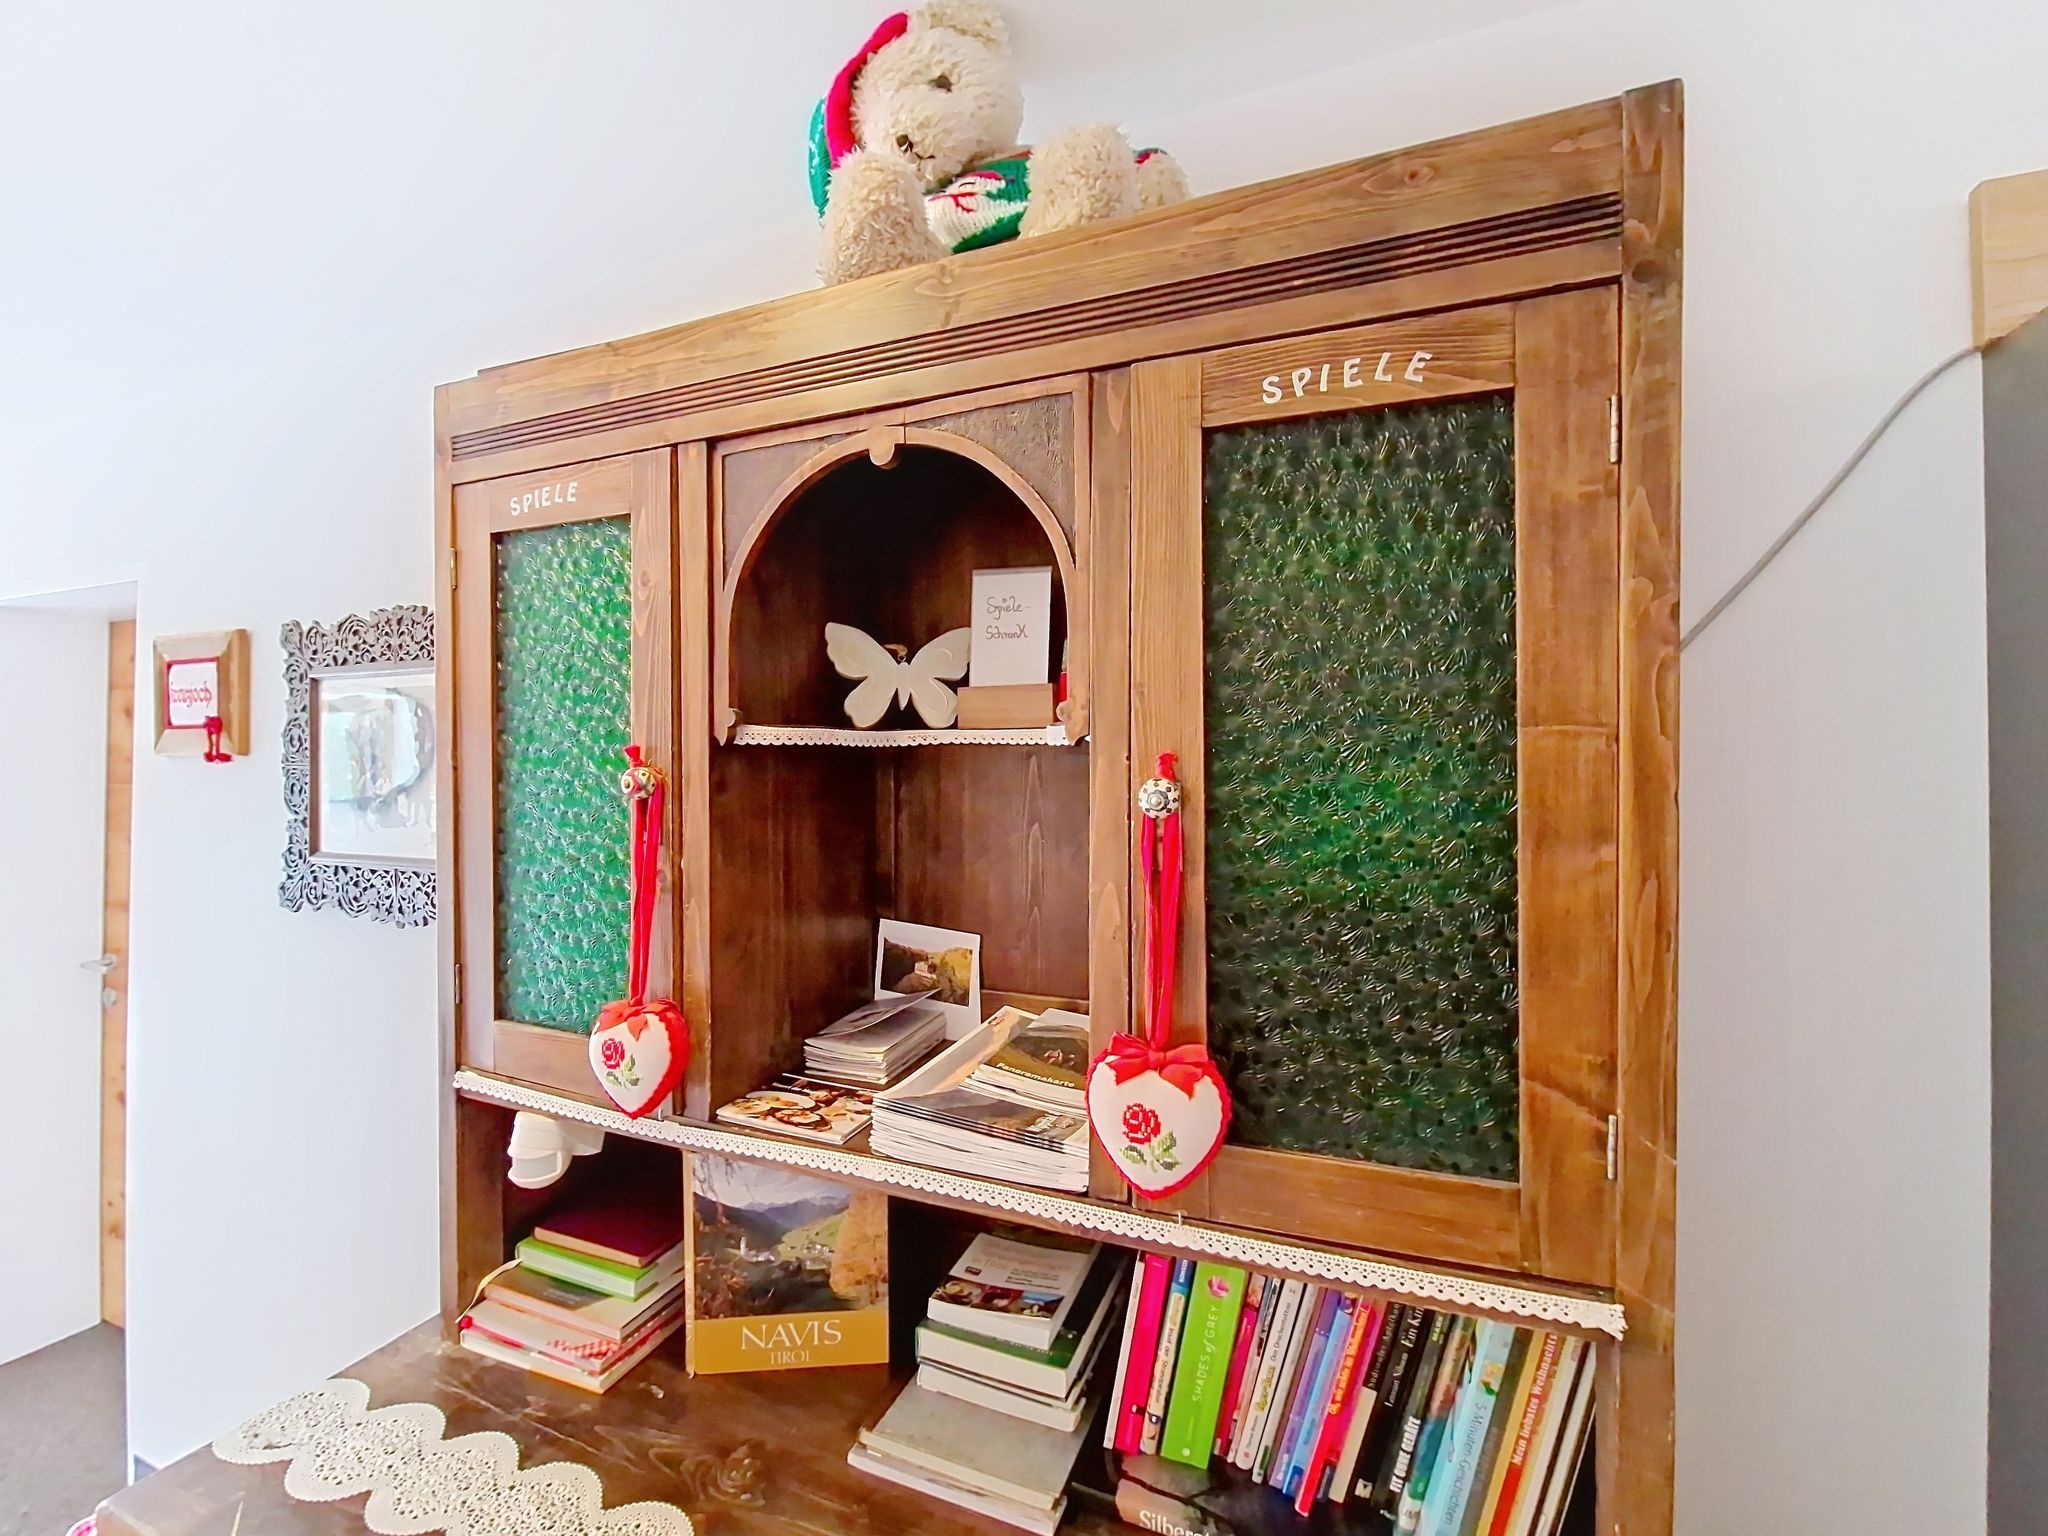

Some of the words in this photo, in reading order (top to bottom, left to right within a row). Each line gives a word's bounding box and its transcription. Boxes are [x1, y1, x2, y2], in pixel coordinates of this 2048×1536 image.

[1262, 351, 1433, 405] SPIELE
[510, 481, 578, 516] SPIELE
[996, 1062, 1076, 1088] Panoramakarte
[741, 1319, 842, 1350] NAVIS
[1205, 1304, 1219, 1337] GREY
[770, 1349, 814, 1364] TIROL
[1206, 1338, 1215, 1354] of
[1193, 1354, 1210, 1402] SHADES
[1511, 1438, 1527, 1466] Mein
